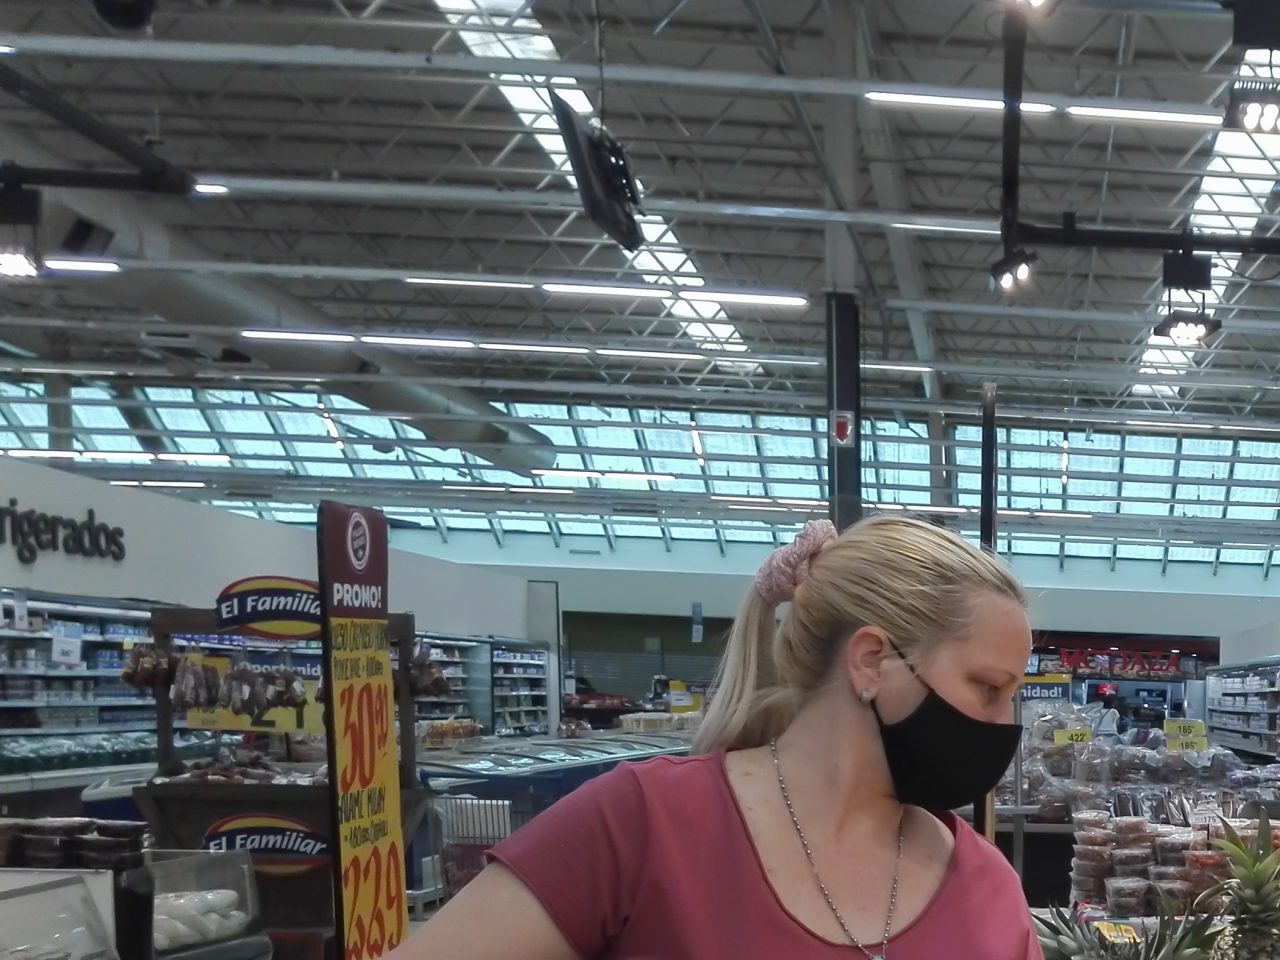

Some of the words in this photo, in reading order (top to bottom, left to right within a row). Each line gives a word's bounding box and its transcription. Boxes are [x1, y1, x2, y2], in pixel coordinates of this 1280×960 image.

[333, 583, 382, 608] PROMO!
[220, 598, 239, 619] El
[236, 832, 328, 855] Familiar
